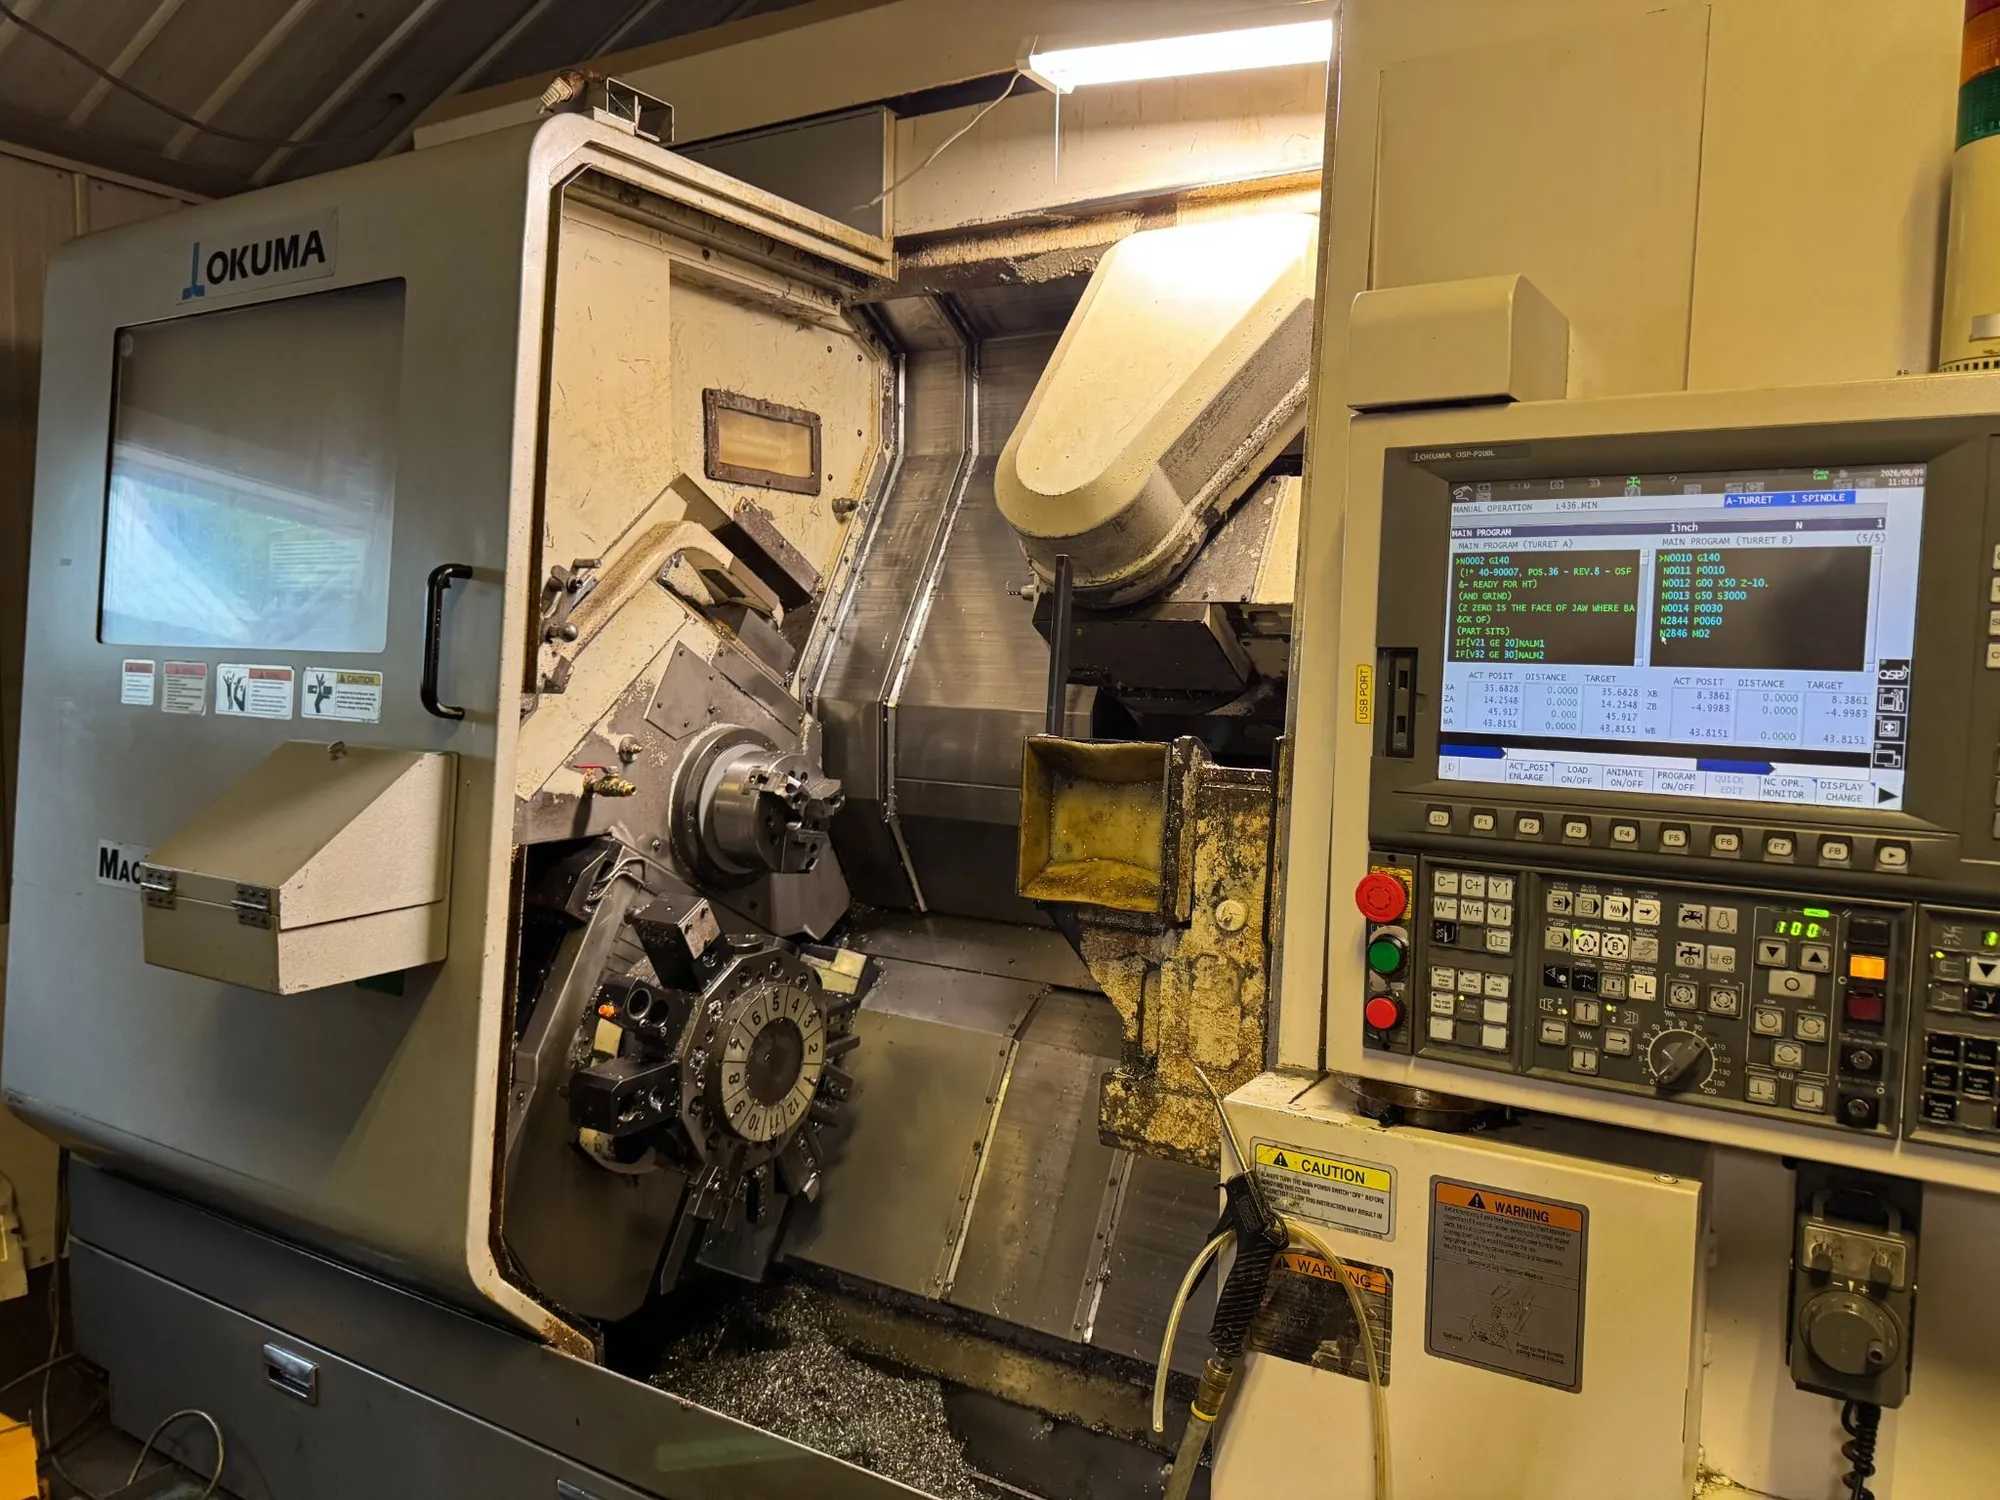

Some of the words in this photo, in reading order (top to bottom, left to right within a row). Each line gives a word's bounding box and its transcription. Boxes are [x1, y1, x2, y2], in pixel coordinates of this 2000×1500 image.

[206, 230, 325, 285] OKUMA
[1725, 496, 1773, 505] A-TURRET
[1802, 494, 1845, 503] SPINDLE
[1453, 505, 1482, 513] MANUAL
[1487, 504, 1533, 512] OPERATION
[1452, 529, 1472, 537] MAIN
[1476, 528, 1511, 536] PROGRAM
[1459, 542, 1480, 550] MAIN
[1483, 541, 1518, 549] PROGRAM
[1523, 540, 1558, 549] (TURRET
[1563, 540, 1574, 549] A)
[1662, 537, 1685, 546] MAIN
[1691, 537, 1730, 546] PROGRAM
[1737, 535, 1776, 545] (TURRET
[1489, 556, 1510, 565] G140
[1697, 553, 1720, 562] G140
[1664, 566, 1691, 575] N0011
[1696, 566, 1725, 575] P0010
[1473, 580, 1497, 589] READY
[1503, 580, 1517, 588] FOR
[1663, 579, 1690, 587] N0012
[1696, 579, 1713, 587] G00
[1718, 579, 1736, 587] X50
[1482, 592, 1512, 600] GRIND)
[1662, 592, 1690, 600] N0013
[1695, 592, 1712, 600] G50
[1717, 592, 1746, 600] S3000
[1472, 604, 1492, 612] ZERO
[1511, 604, 1526, 612] THE
[1531, 604, 1552, 612] FACE
[1556, 604, 1567, 612] OF
[1592, 604, 1619, 612] WHERE
[1662, 604, 1689, 613] N0014
[1694, 604, 1723, 613] P0030
[1660, 617, 1688, 625] N2844
[1694, 617, 1722, 625] P0060
[1457, 627, 1480, 635] (PART
[1485, 627, 1510, 636] SITS)
[1660, 629, 1688, 638] N2846
[1490, 639, 1500, 647] GE
[1489, 650, 1499, 658] GE
[1488, 672, 1513, 680] POSIT
[1525, 673, 1566, 681] DISTANCE
[1585, 675, 1616, 683] TARGET
[1360, 670, 1369, 696] PORT
[1673, 677, 1691, 685] ACT
[1696, 677, 1725, 686] POSIT
[1738, 679, 1785, 688] DISTANCE
[1807, 681, 1844, 690] TARGET
[1547, 686, 1578, 695] 0.0000
[1762, 693, 1798, 702] 0.0000
[1546, 698, 1578, 707] 0.0000
[1359, 700, 1368, 720] USB
[1444, 706, 1454, 714] CA
[1487, 708, 1518, 716] 45.917
[1551, 710, 1577, 719] 0.000
[1605, 712, 1638, 721] 45.917
[1762, 706, 1798, 715] 0.0000
[1545, 722, 1576, 730] 0.0000
[1760, 731, 1796, 741] 0.0000
[1568, 765, 1588, 774] LOAD
[1607, 768, 1644, 777] ANIMATE
[1509, 772, 1544, 781] ENLARGE
[1561, 775, 1593, 784] ON/OFF
[1657, 771, 1696, 780] PROGRAM
[1611, 778, 1643, 788] ON/OFF
[1661, 782, 1696, 792] ON/OFF
[1764, 778, 1777, 787] NC
[1781, 779, 1804, 788] OPR.
[1821, 781, 1863, 791] DISPLAY
[1763, 788, 1805, 799] MONITOR
[1826, 792, 1863, 802] CHANGE
[1478, 817, 1488, 825] F1
[1524, 822, 1535, 830] F2
[1619, 830, 1630, 839] F4
[1669, 834, 1680, 842] F5
[1721, 838, 1732, 847] F6
[1774, 842, 1785, 851] F7
[1775, 921, 1820, 938] 100
[1583, 939, 1591, 948] A
[1612, 942, 1619, 951] B
[772, 1000, 780, 1012] 5
[791, 999, 800, 1013] 4
[752, 1011, 762, 1026] 6
[804, 1014, 815, 1028] 3
[808, 1043, 818, 1055] 2
[728, 1073, 739, 1084] 8
[787, 1100, 800, 1115] 12
[1301, 1159, 1365, 1185] CAUTION
[1495, 1201, 1550, 1223] WARNING
